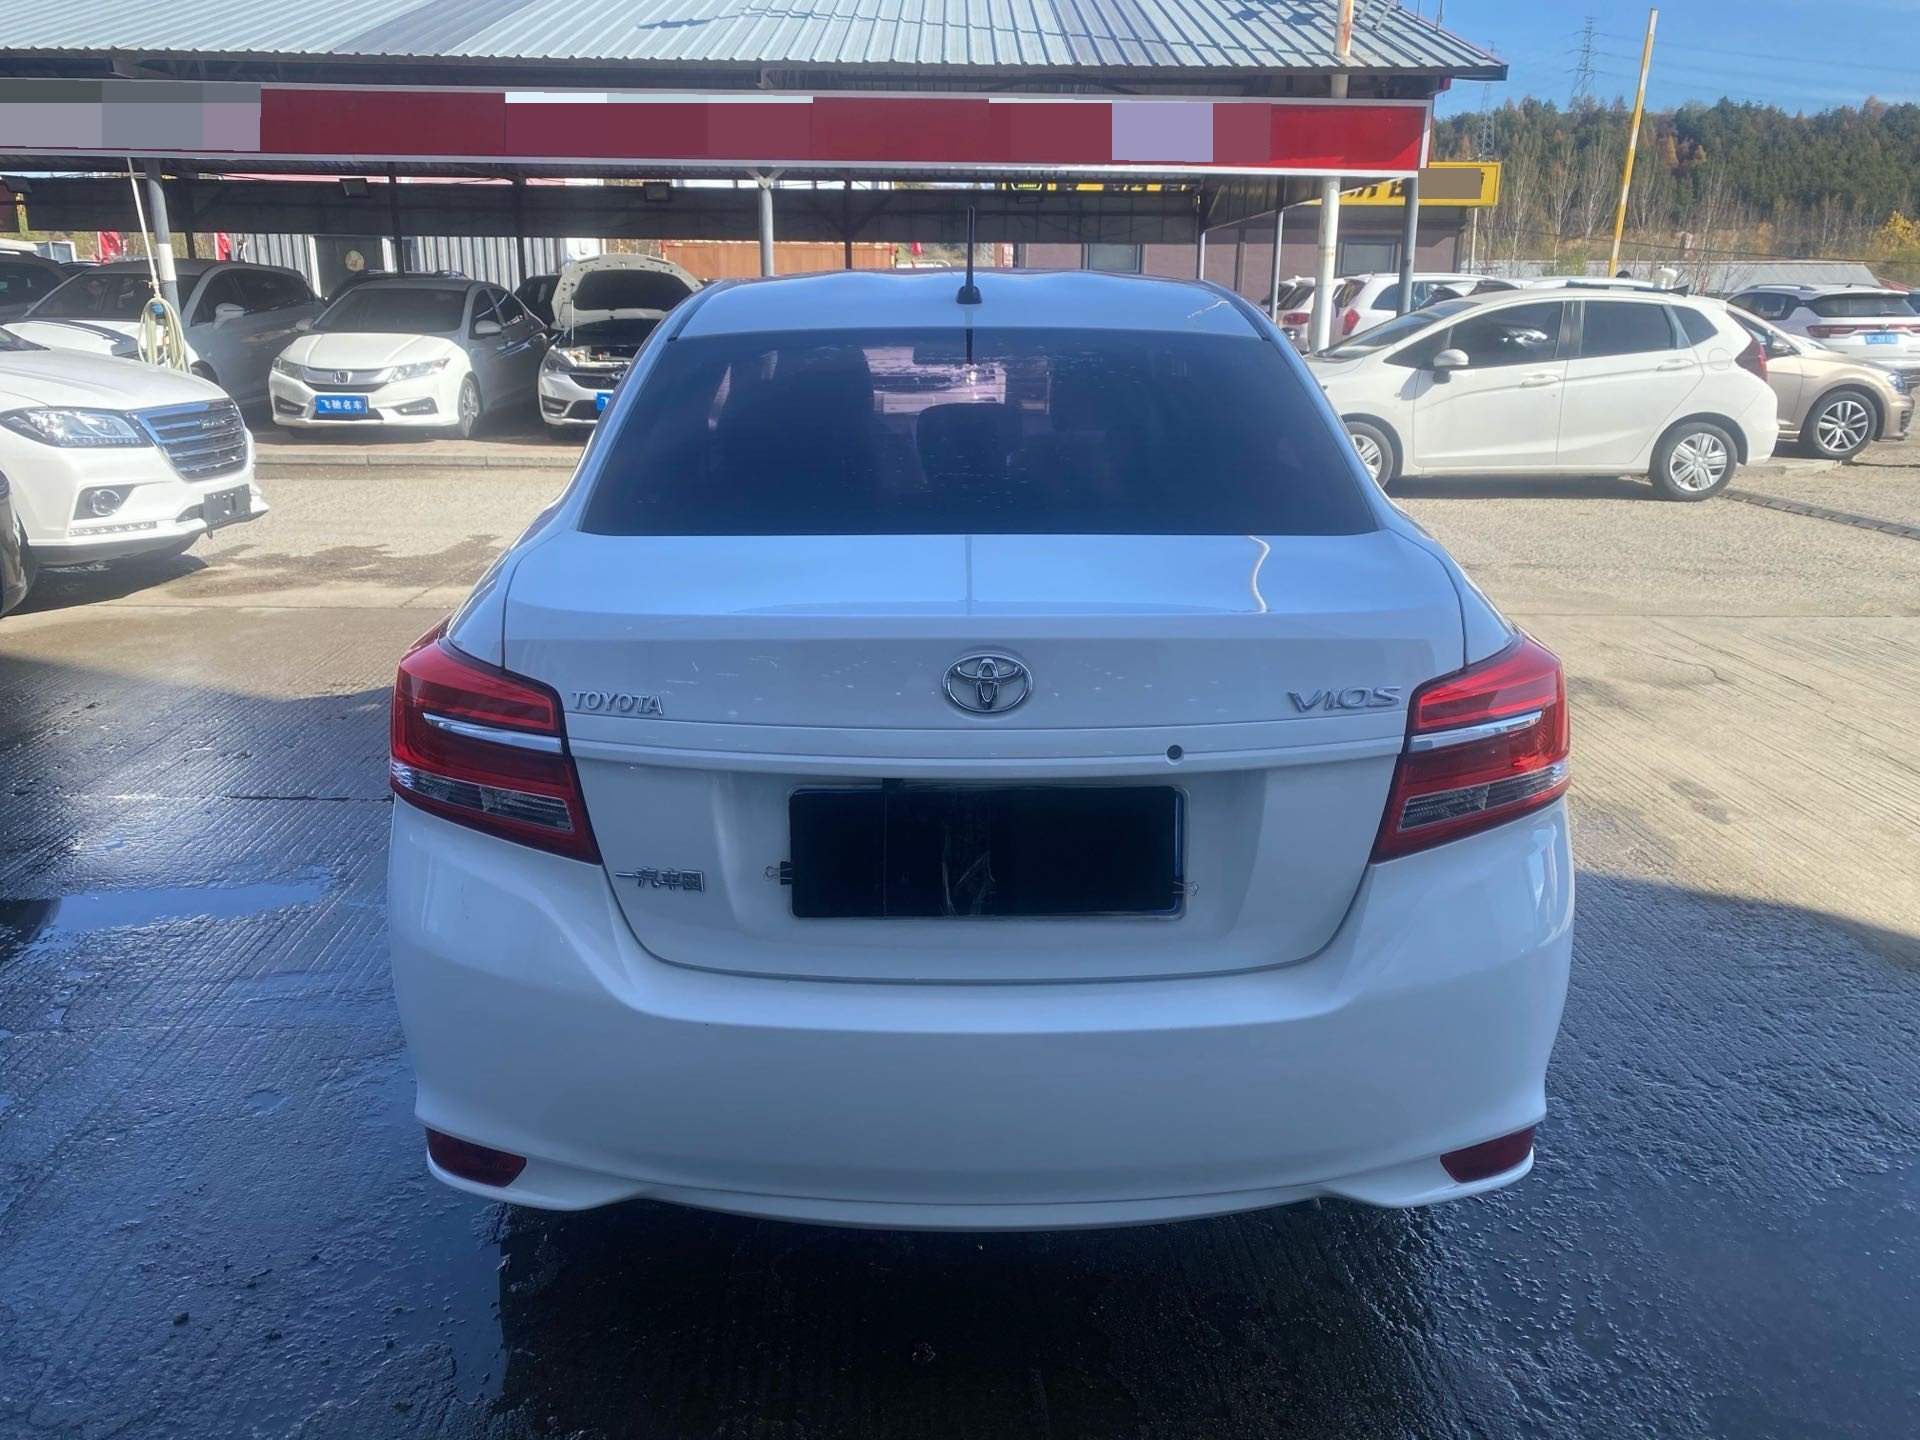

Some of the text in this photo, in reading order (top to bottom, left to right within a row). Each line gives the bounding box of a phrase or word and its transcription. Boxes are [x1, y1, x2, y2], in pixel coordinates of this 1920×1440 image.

[320, 399, 362, 410] 飞驰名车
[571, 690, 664, 716] TOYOTA
[1287, 685, 1402, 712] VIOS
